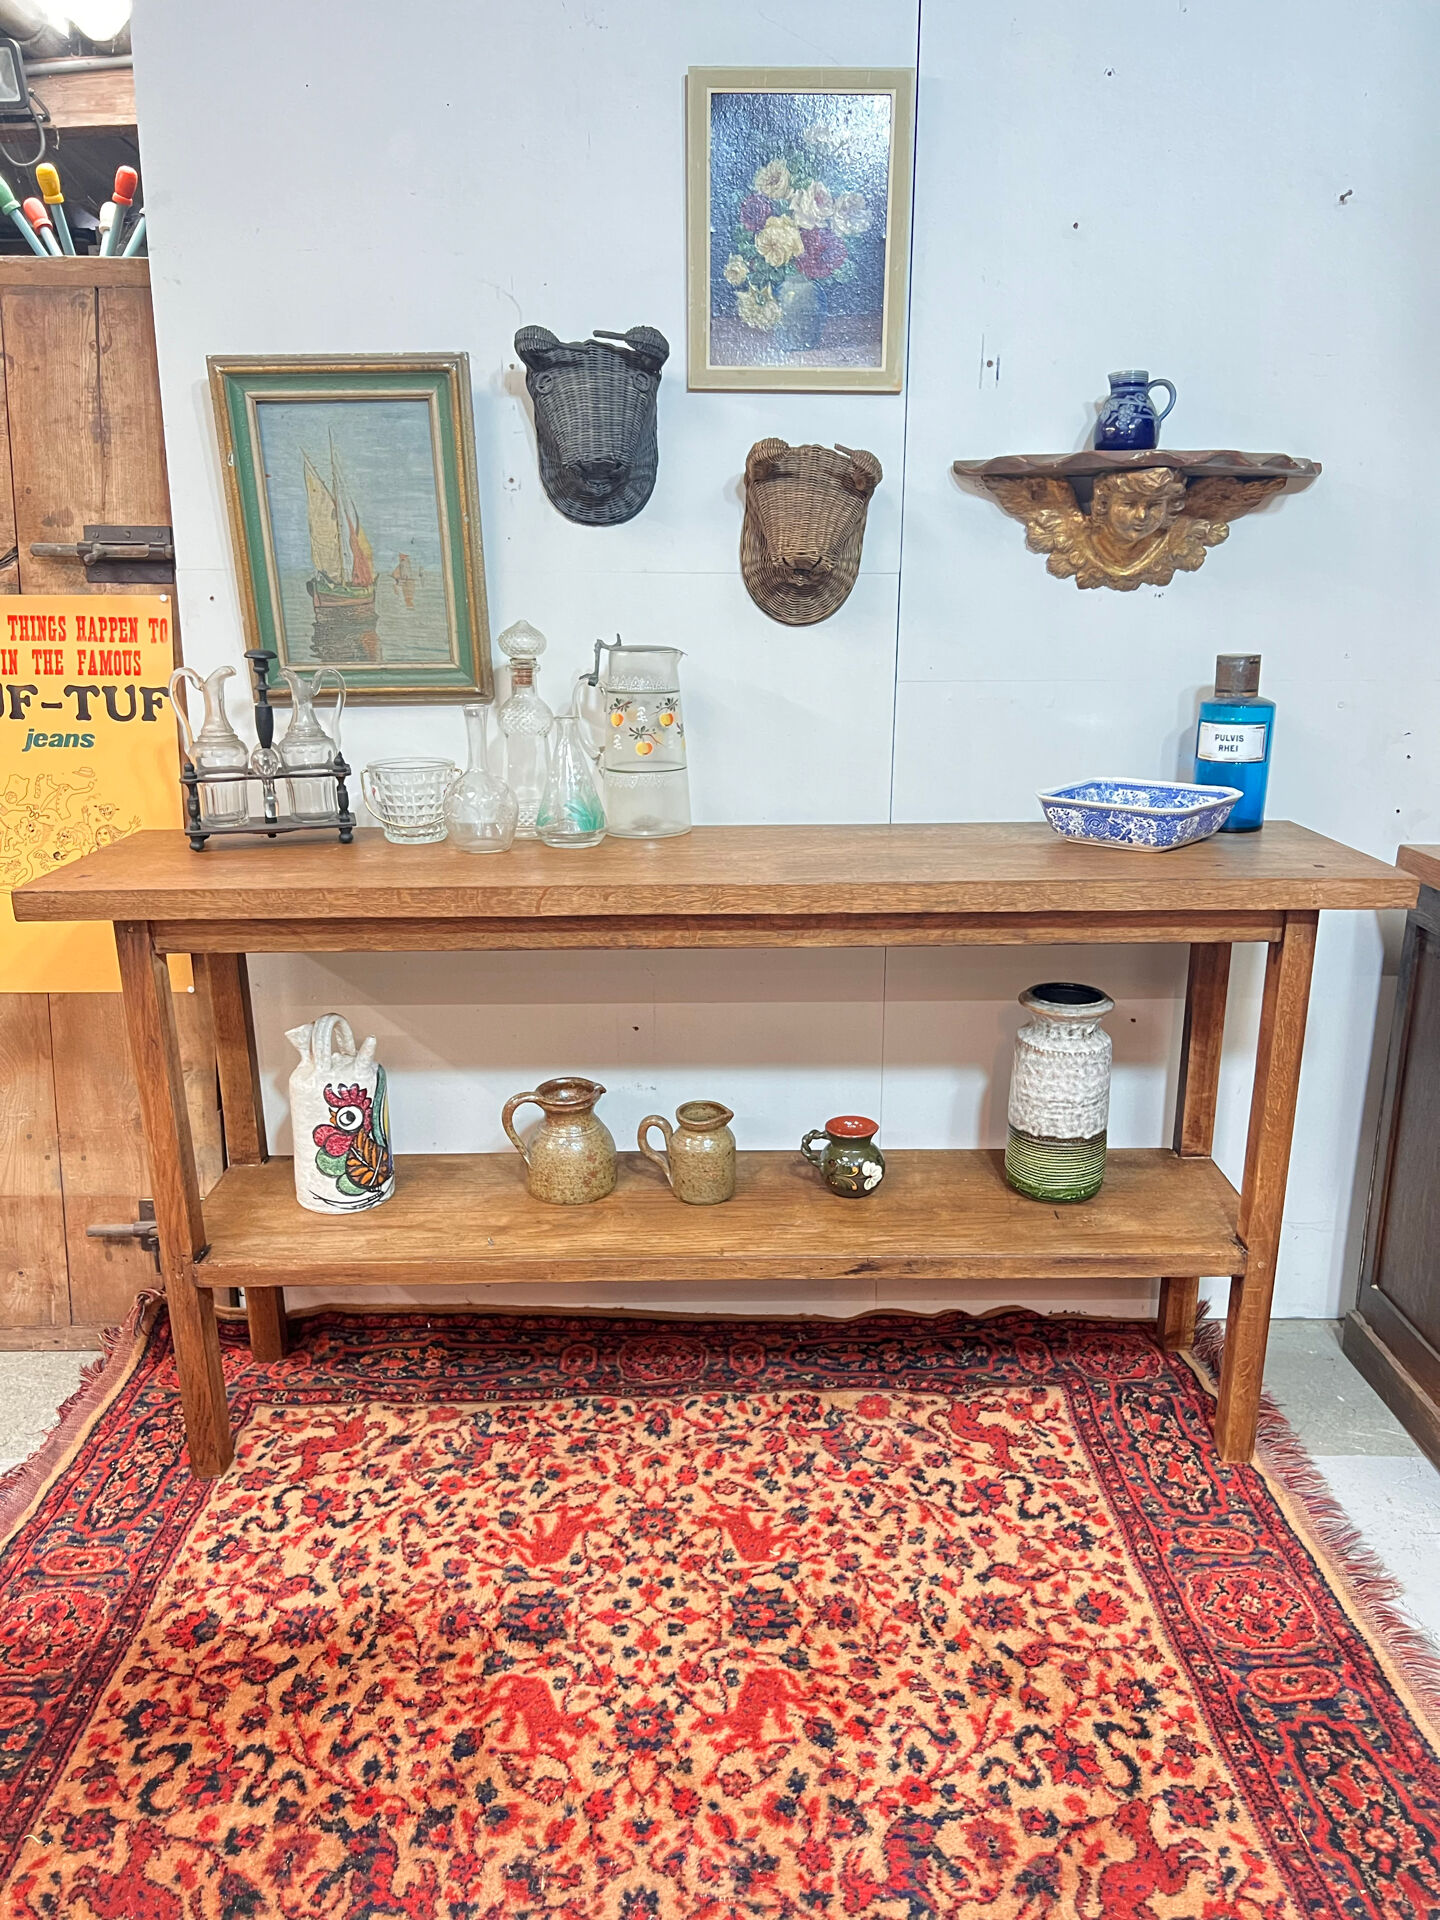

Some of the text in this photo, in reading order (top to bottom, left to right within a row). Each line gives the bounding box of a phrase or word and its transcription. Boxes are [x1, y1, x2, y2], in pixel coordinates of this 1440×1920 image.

[7, 614, 169, 644] THINGS HAPPEN TO
[1, 648, 142, 676] IN THE FAMOUS
[0, 683, 169, 722] F-TUF
[22, 728, 96, 752] jeans
[1214, 733, 1244, 742] PULVIS
[1218, 744, 1239, 752] RHEI
